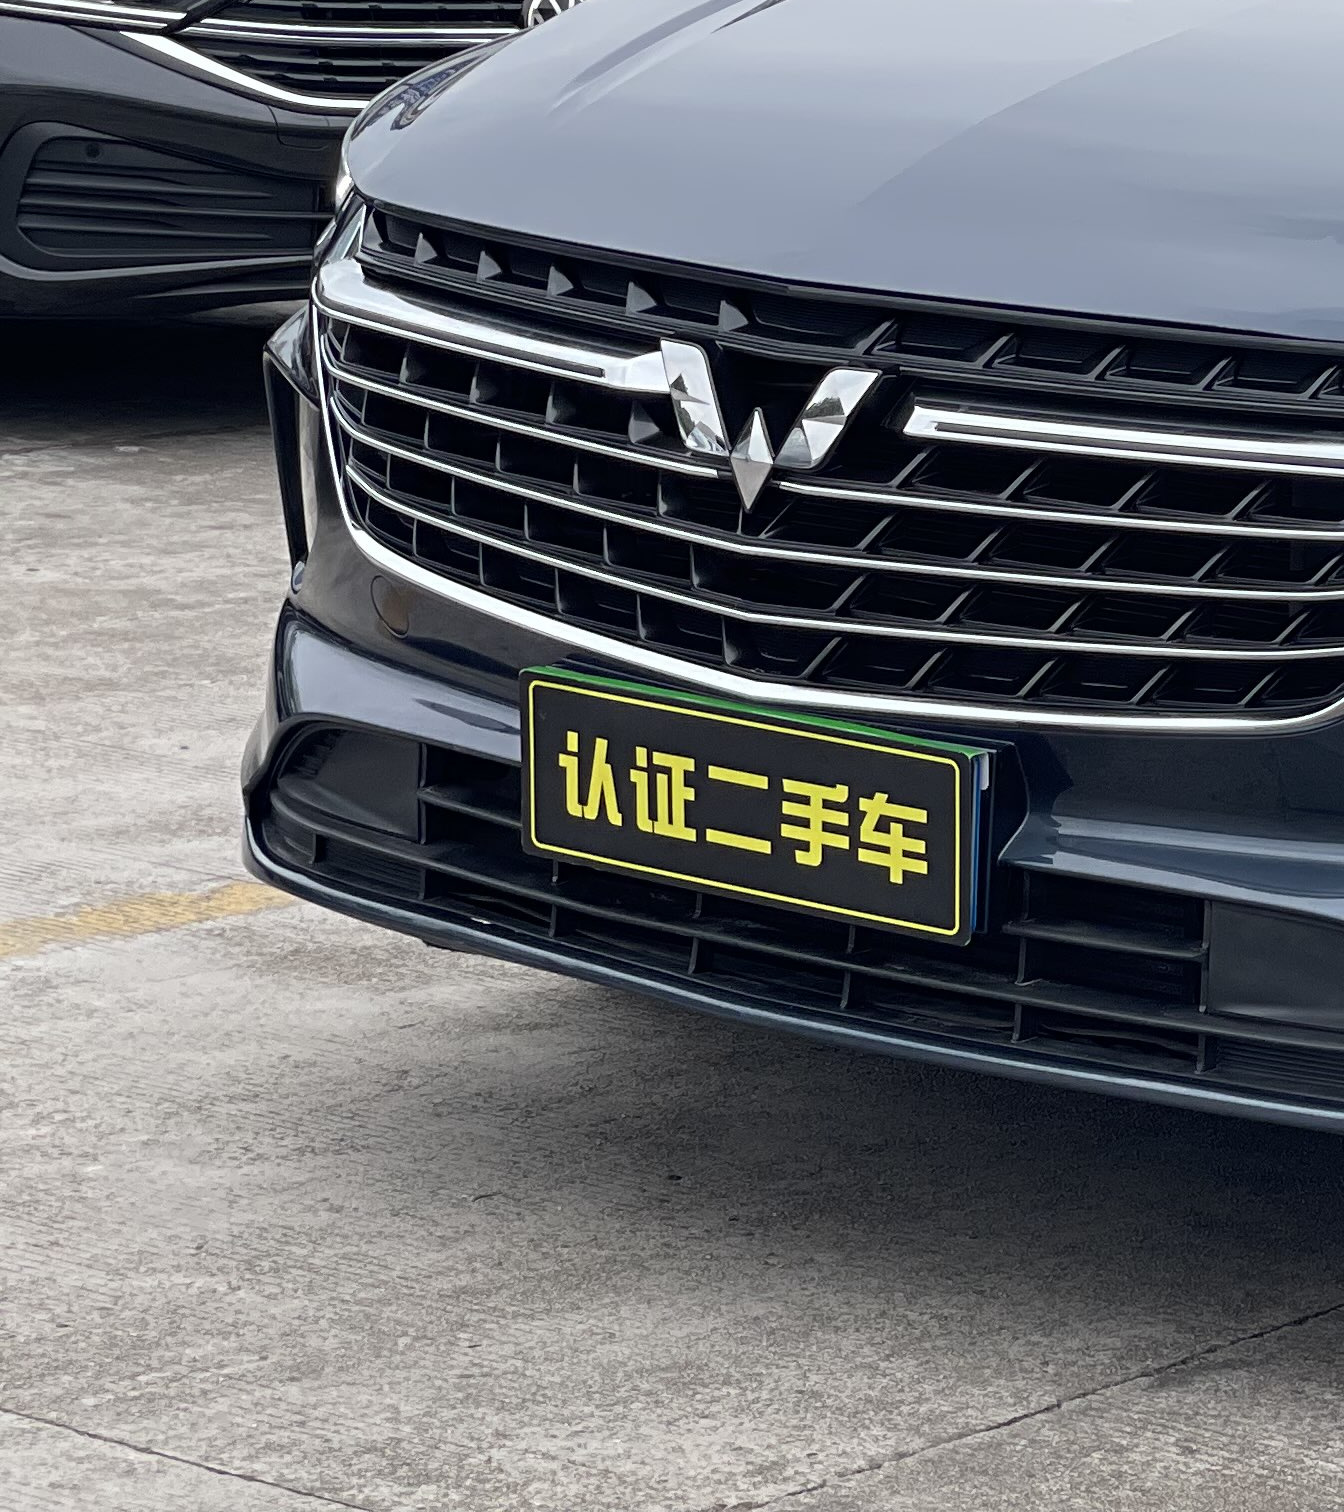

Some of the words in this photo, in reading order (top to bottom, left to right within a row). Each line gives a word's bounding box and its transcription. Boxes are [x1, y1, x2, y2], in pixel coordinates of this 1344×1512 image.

[557, 729, 929, 885] 认证二手车
